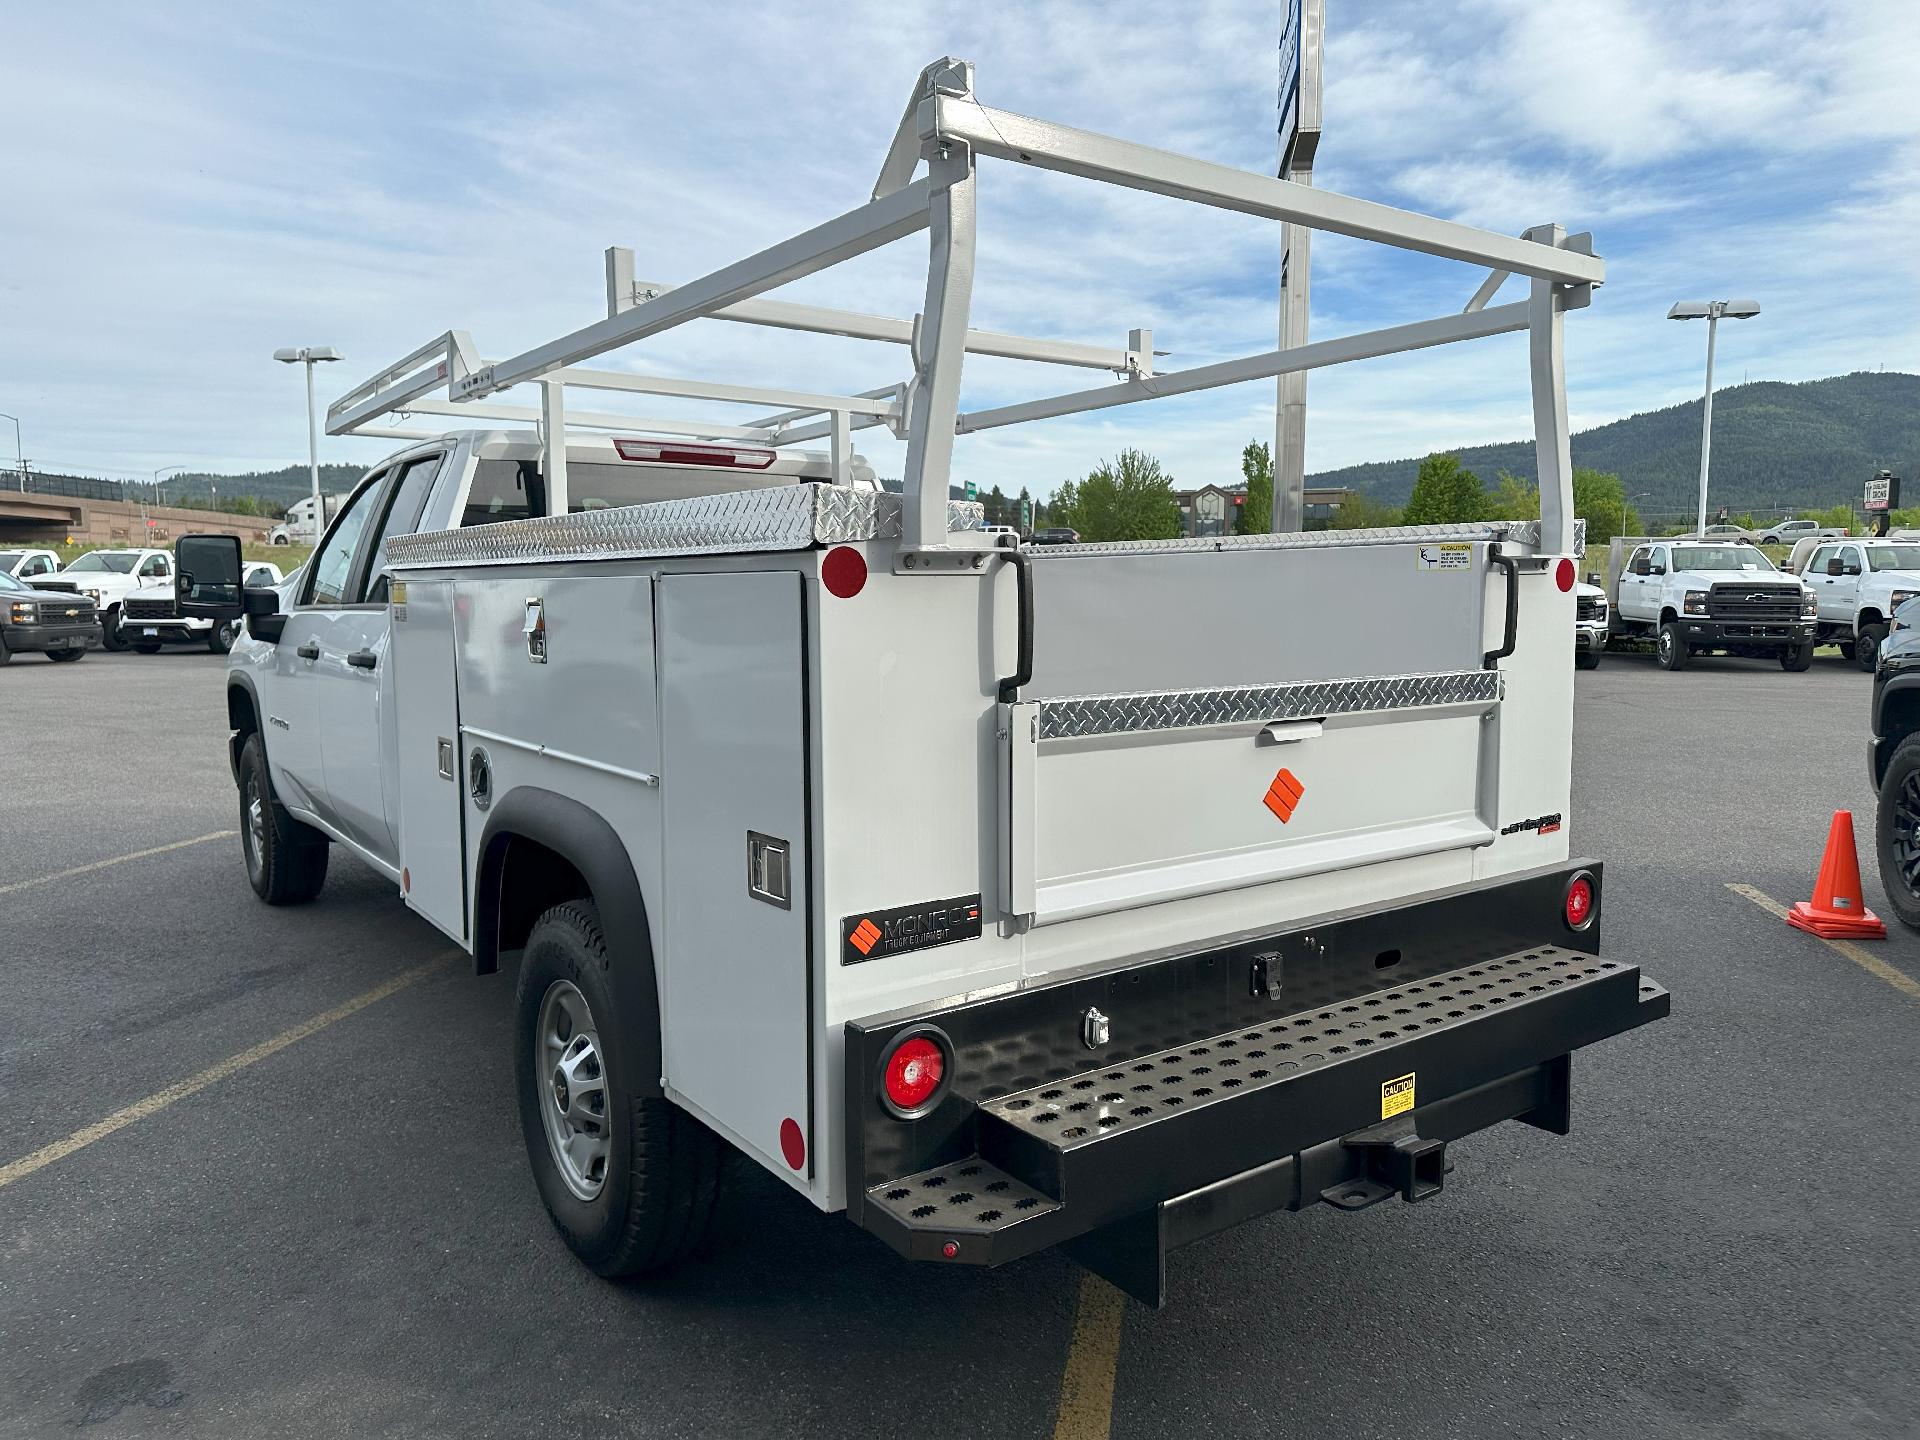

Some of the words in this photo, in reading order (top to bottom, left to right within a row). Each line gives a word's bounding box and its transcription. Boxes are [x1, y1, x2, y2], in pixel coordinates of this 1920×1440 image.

[885, 904, 978, 939] MONROE
[885, 937, 909, 950] TRUCK
[909, 929, 950, 944] EQUIPMENT
[1384, 1079, 1413, 1097] CAUTION
